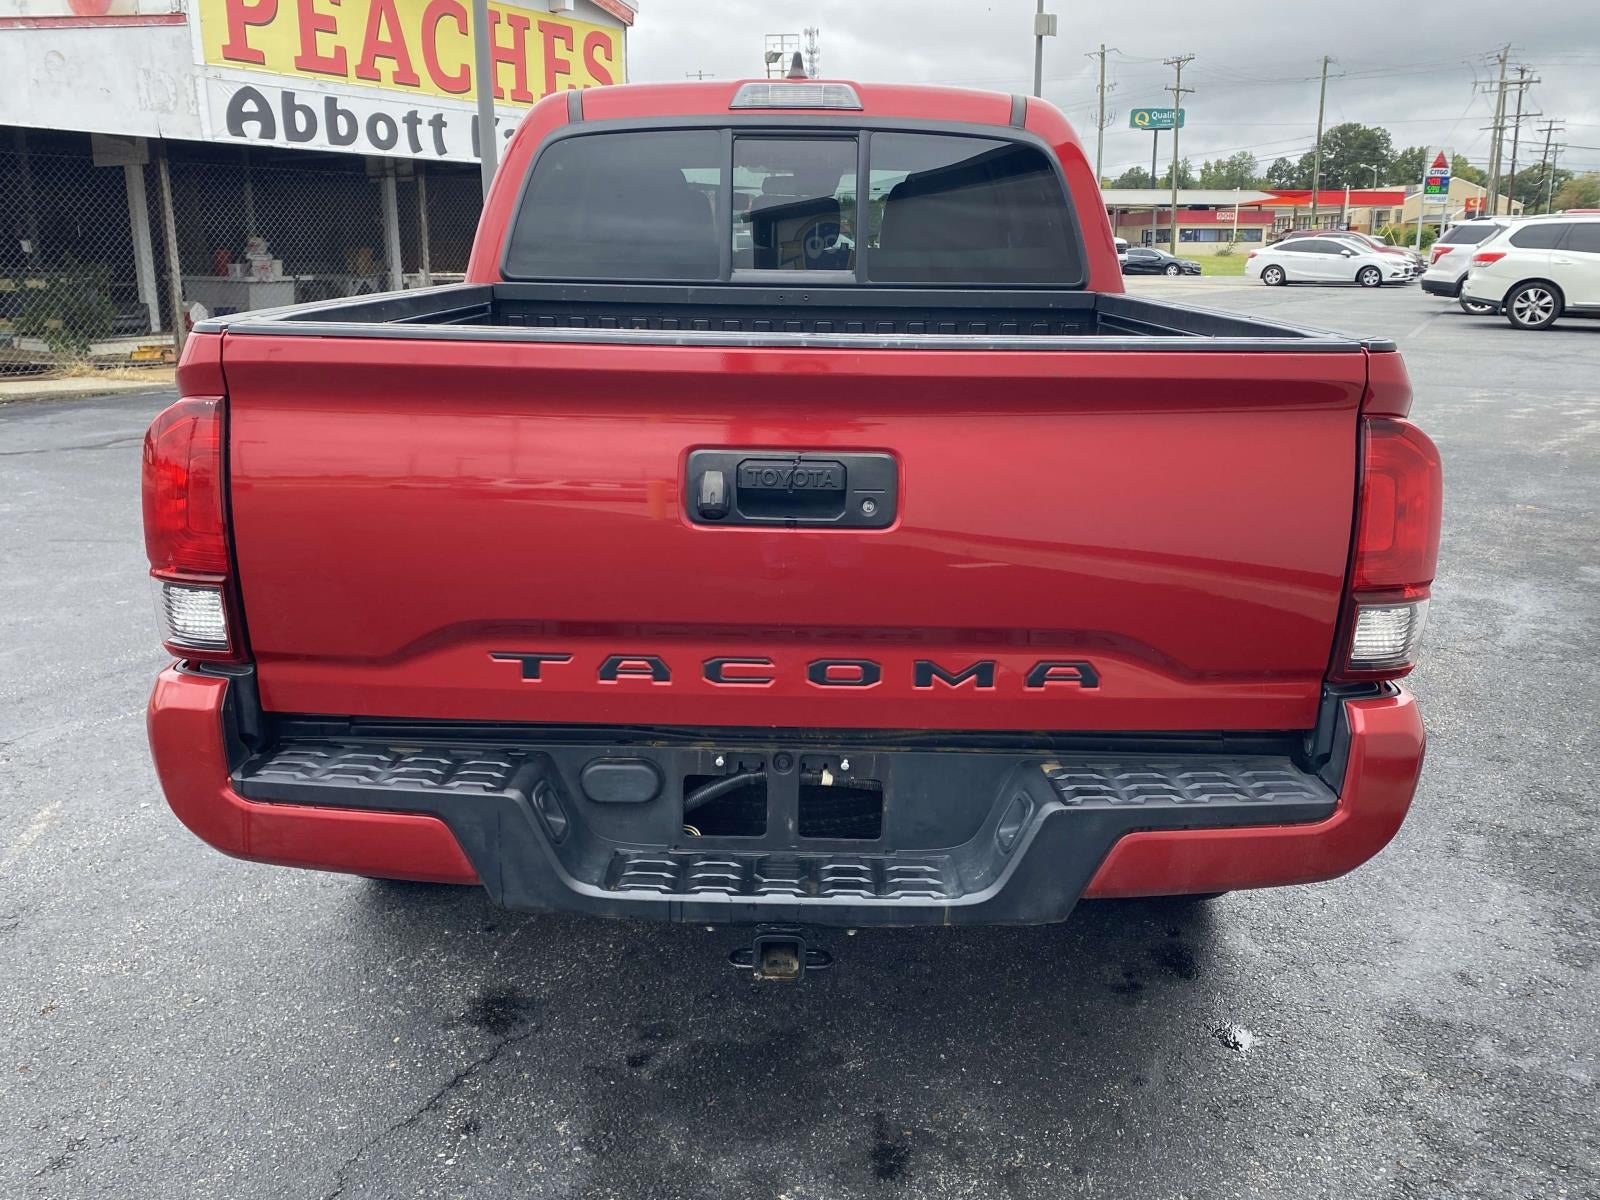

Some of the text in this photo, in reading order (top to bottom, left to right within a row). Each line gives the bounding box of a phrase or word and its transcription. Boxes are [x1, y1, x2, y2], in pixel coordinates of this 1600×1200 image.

[221, 0, 613, 104] PEACHES
[226, 86, 448, 156] Abbott
[747, 468, 838, 488] TOYOTA
[488, 651, 1102, 691] TACOMA
